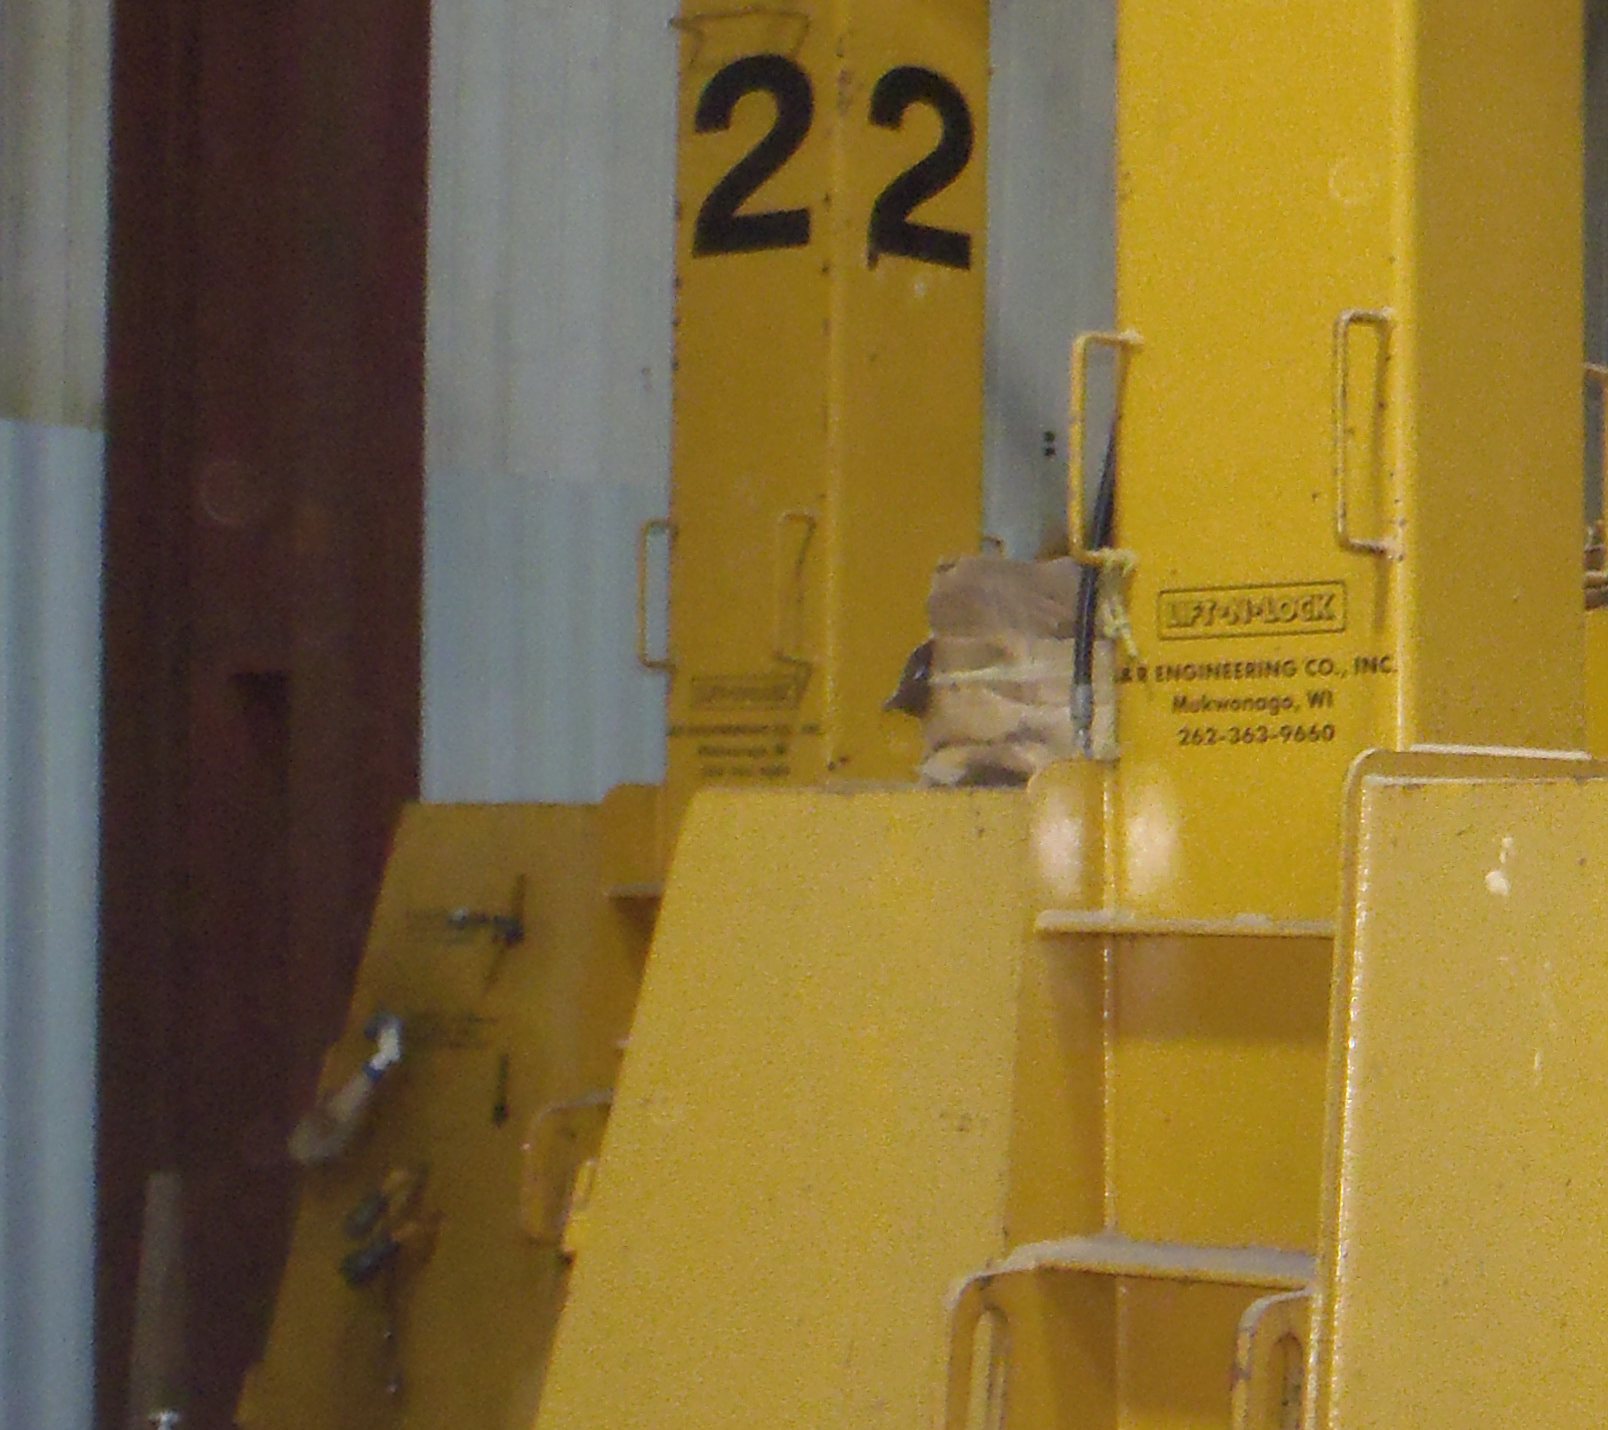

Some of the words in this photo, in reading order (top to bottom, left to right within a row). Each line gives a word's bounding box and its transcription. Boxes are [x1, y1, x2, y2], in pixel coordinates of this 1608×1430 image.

[691, 52, 814, 259] 2
[866, 64, 975, 271] 2
[1154, 658, 1298, 684] ENGINEERING
[1306, 689, 1334, 710] WI
[1176, 723, 1336, 747] 262-363-9660
